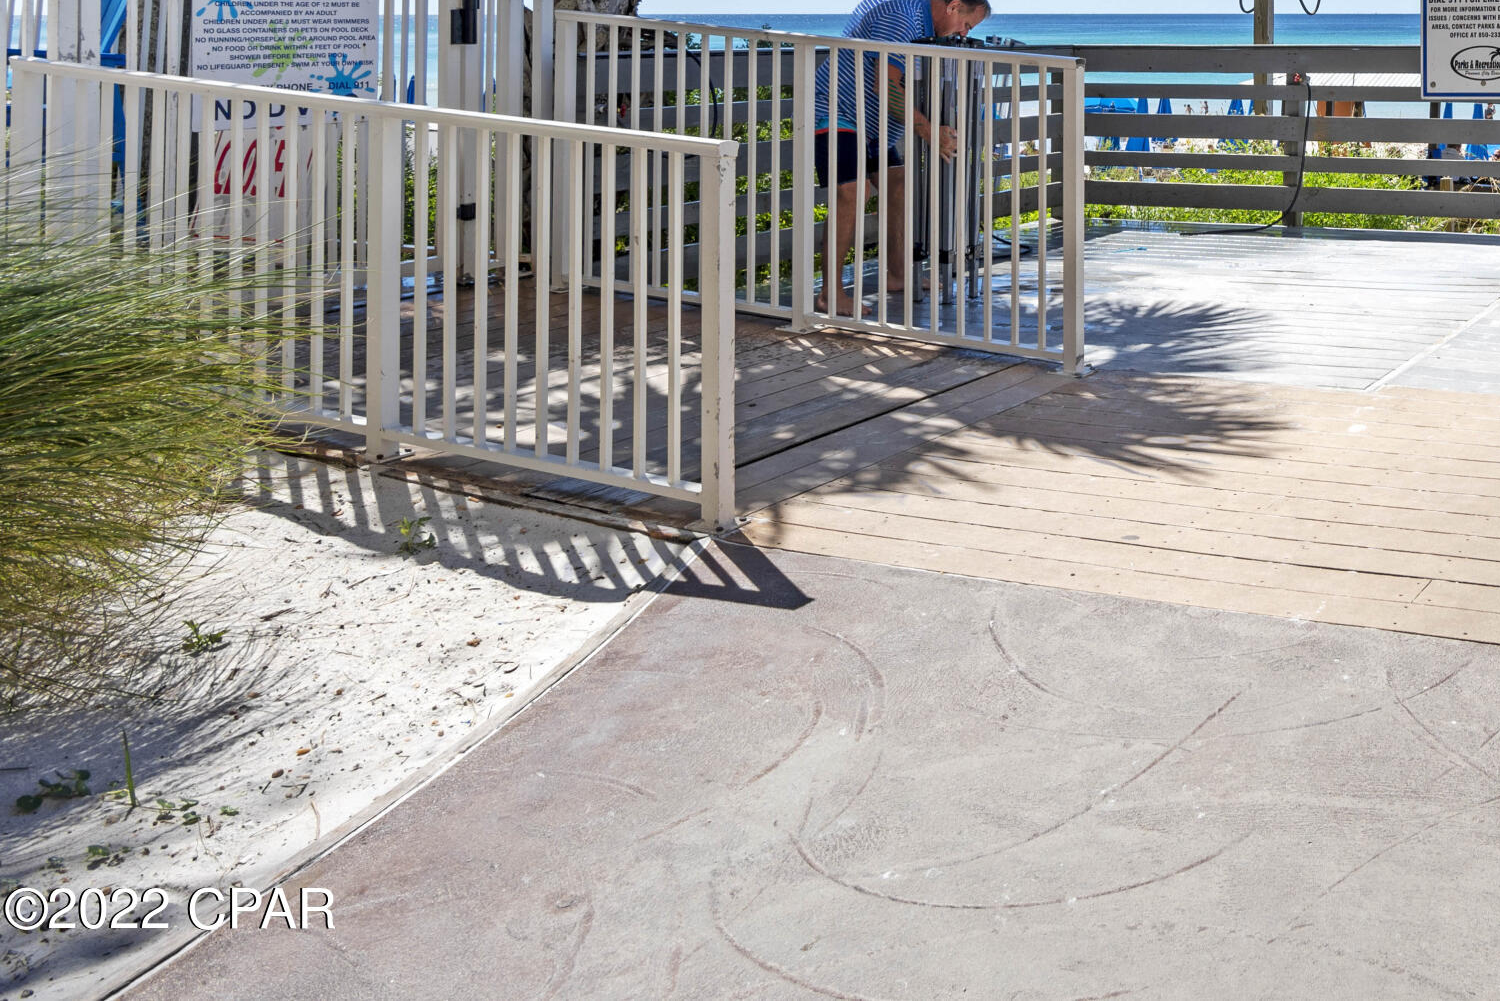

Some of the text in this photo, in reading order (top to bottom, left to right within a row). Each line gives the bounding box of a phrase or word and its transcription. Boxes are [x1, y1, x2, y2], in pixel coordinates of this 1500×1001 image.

[1455, 60, 1469, 69] Parks
[276, 83, 313, 91] PHONE
[328, 82, 351, 90] DIAL
[353, 81, 369, 89] 911
